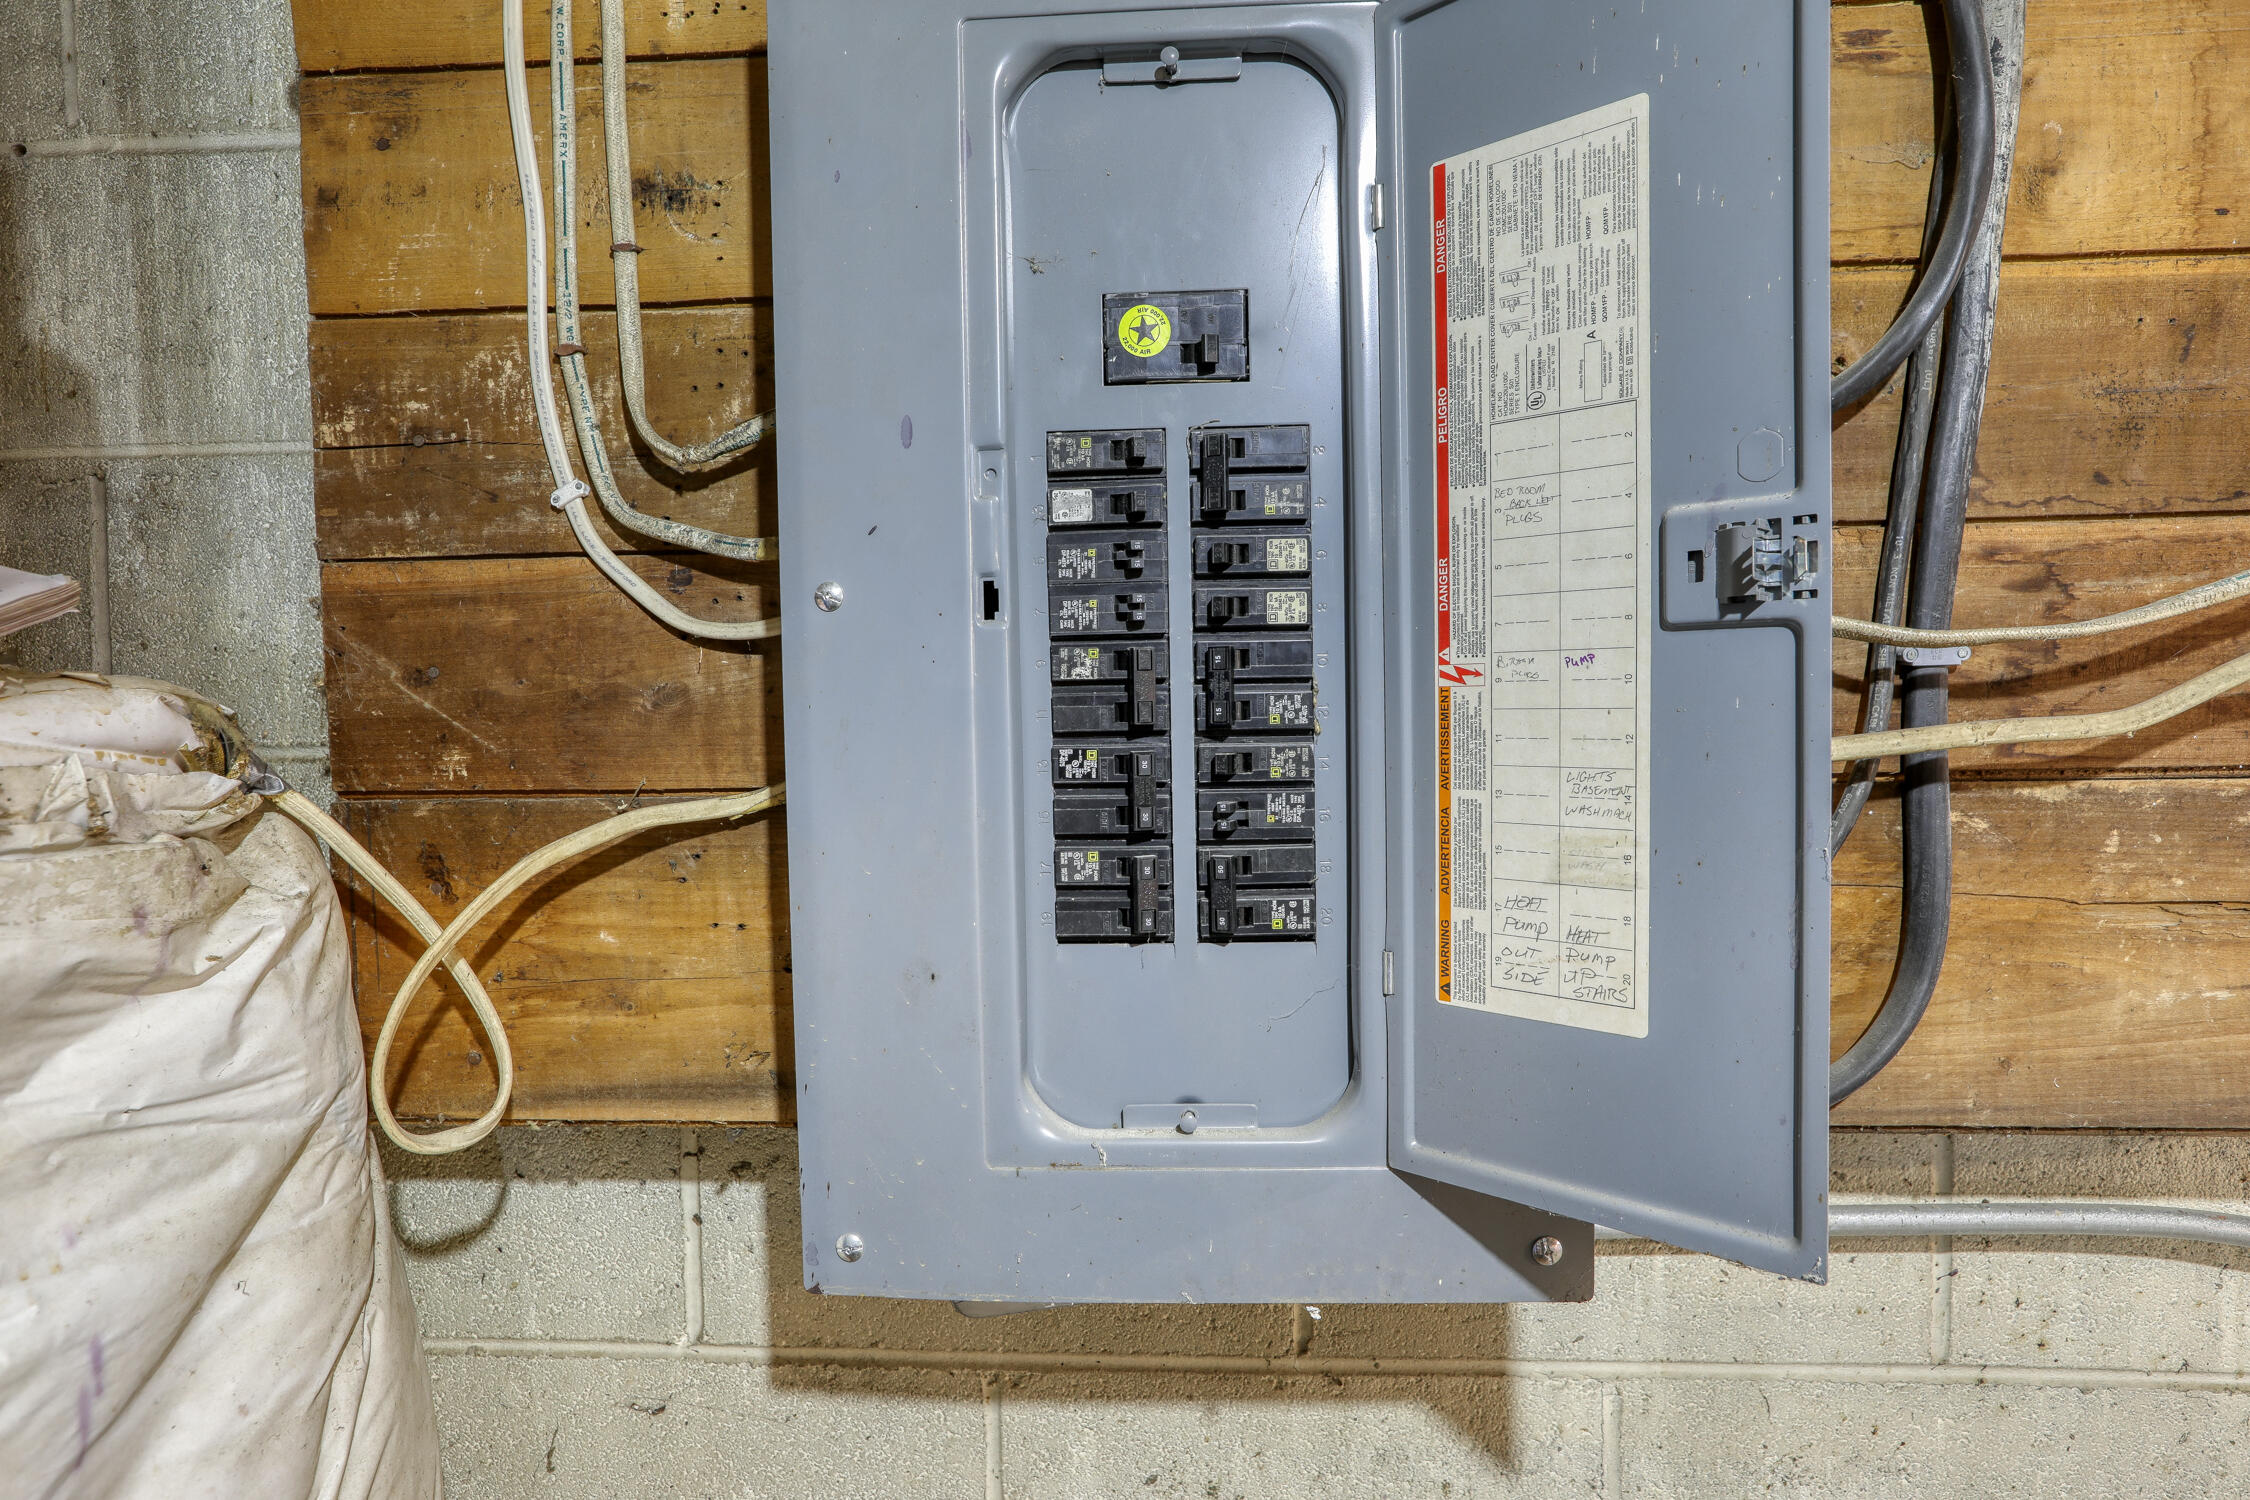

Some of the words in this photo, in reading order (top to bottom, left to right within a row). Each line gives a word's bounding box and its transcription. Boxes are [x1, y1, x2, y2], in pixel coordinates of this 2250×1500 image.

[556, 22, 565, 59] CORP.
[1489, 227, 1494, 236] DE
[1436, 218, 1446, 274] DANGER
[1586, 330, 1596, 339] A
[576, 383, 590, 414] TYPE
[1530, 394, 1542, 406] UL
[1438, 387, 1448, 444] PELIGRO
[1494, 487, 1513, 499] BED
[1510, 498, 1530, 509] BACK
[1506, 512, 1543, 526] PLUGS
[1439, 558, 1448, 611] DANGER
[1564, 654, 1596, 668] PUMP
[1625, 674, 1632, 684] 10
[1873, 646, 1887, 701] SHEHED
[1216, 708, 1221, 716] 15
[1440, 688, 1449, 790] AVERTISSEMENT
[1626, 734, 1634, 744] 12
[1566, 771, 1616, 783] LIGHTS
[1495, 789, 1502, 799] 13
[1571, 783, 1635, 795] BASEMENT
[1624, 795, 1632, 805] 14
[1565, 804, 1600, 816] WASH
[1143, 813, 1149, 821] 30
[1441, 807, 1449, 895] ADVERTENCIA
[1495, 845, 1502, 855] 15
[1624, 855, 1632, 865] 16
[1218, 865, 1224, 873] 50
[1495, 903, 1502, 911] 17
[1220, 917, 1225, 925] 50
[1623, 916, 1631, 926] 18
[1441, 920, 1449, 977] WARNING
[1501, 947, 1542, 958] OUT
[1495, 956, 1502, 965] 19
[1503, 967, 1549, 985] SIDE
[1564, 968, 1596, 985] UP
[1623, 974, 1631, 985] 20
[1573, 985, 1628, 1003] STAIRS
